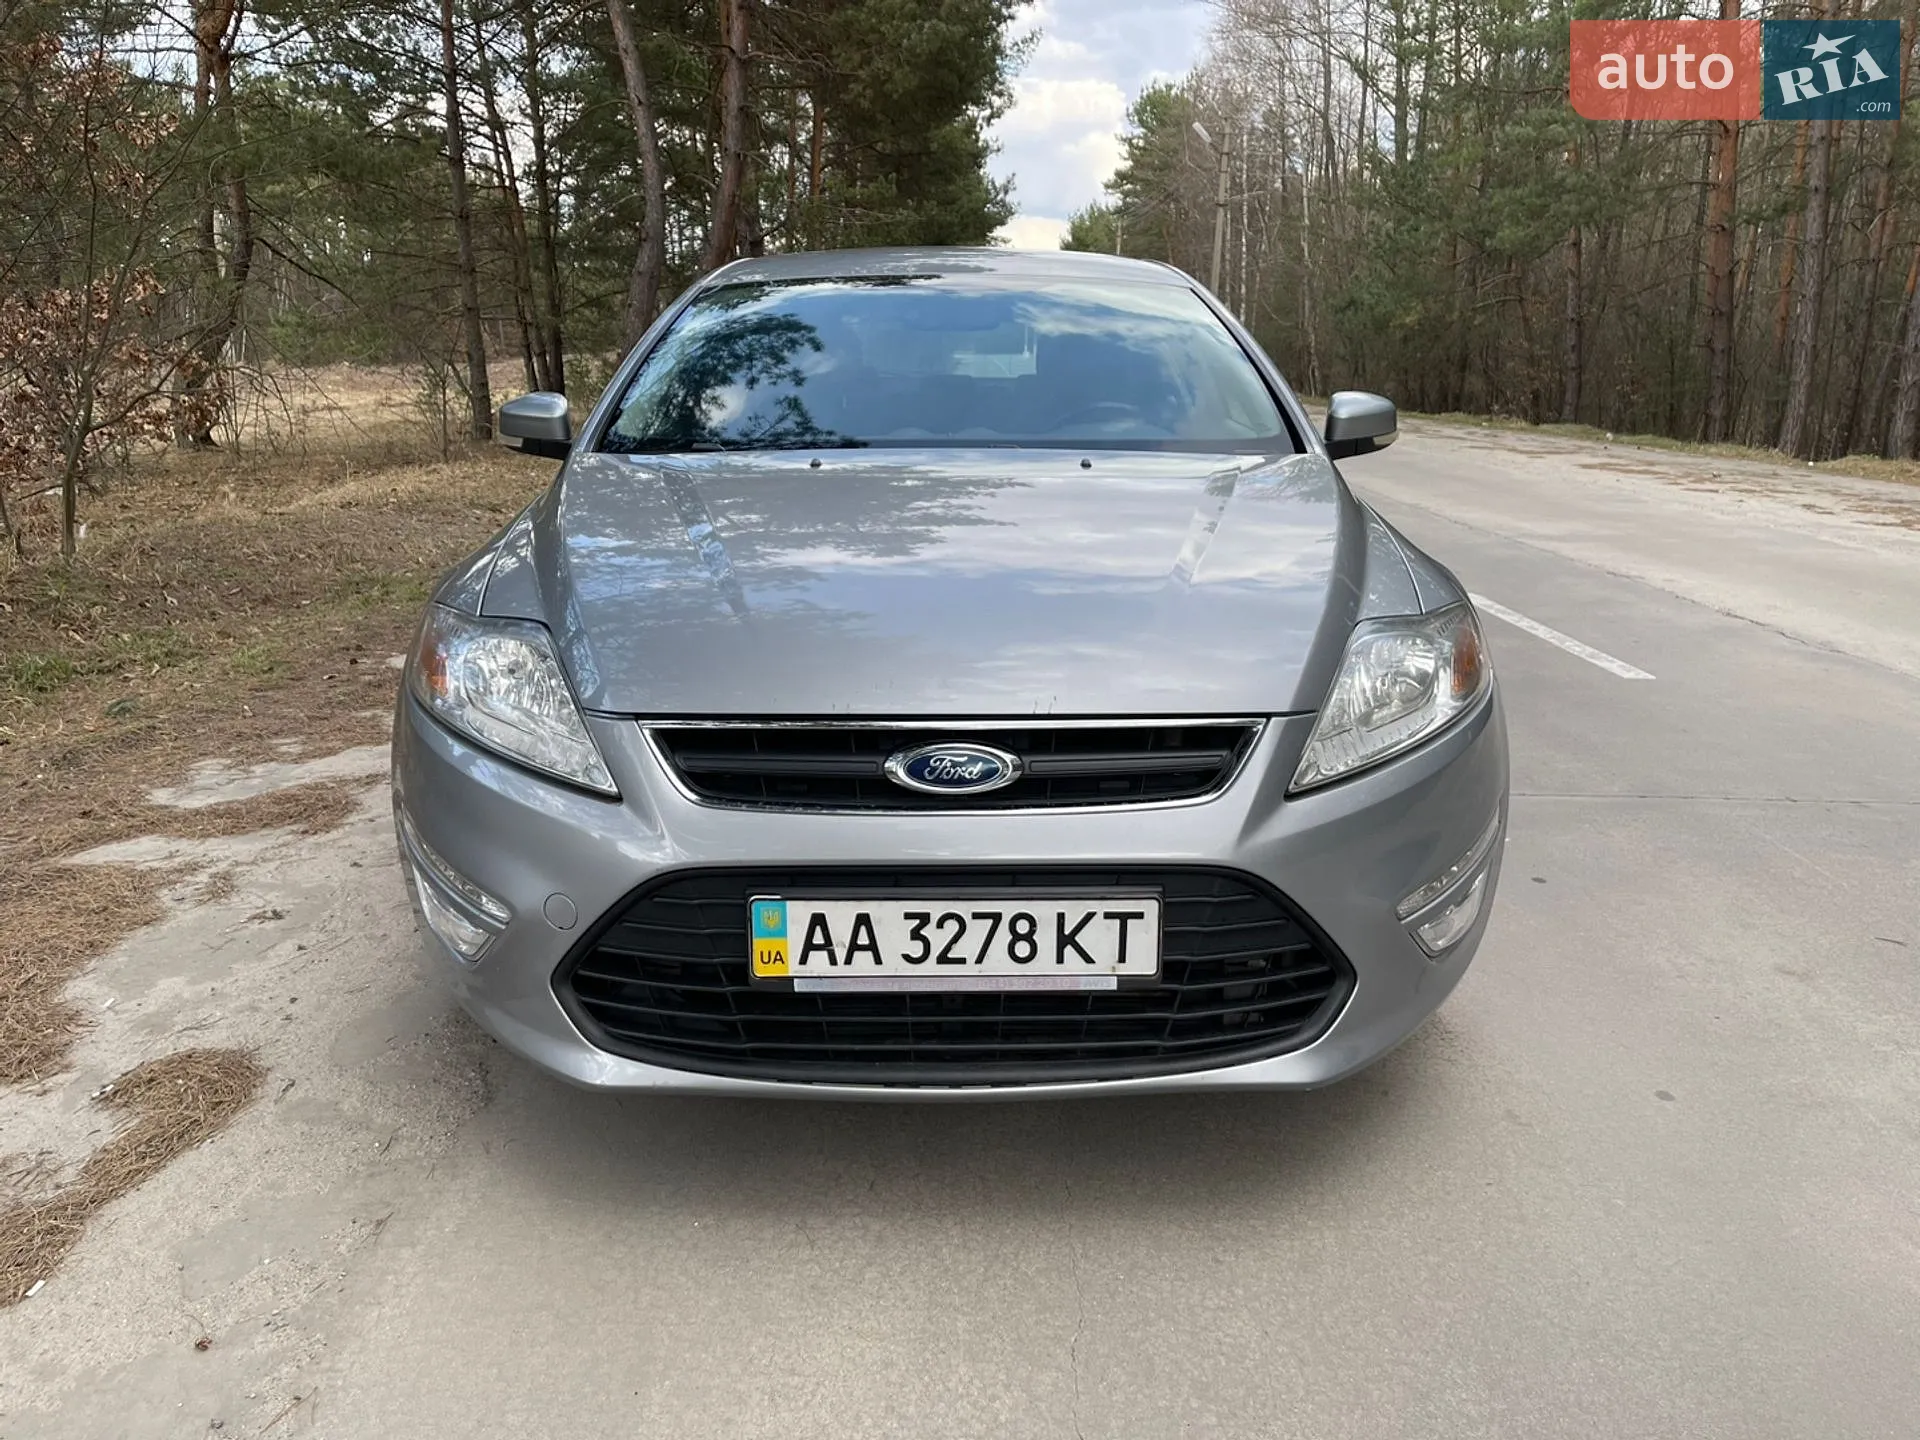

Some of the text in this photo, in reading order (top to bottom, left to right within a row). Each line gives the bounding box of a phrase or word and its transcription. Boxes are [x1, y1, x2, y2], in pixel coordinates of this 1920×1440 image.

[923, 755, 983, 780] Ford
[798, 911, 1145, 966] AA 3278 KT
[760, 950, 785, 965] UA
